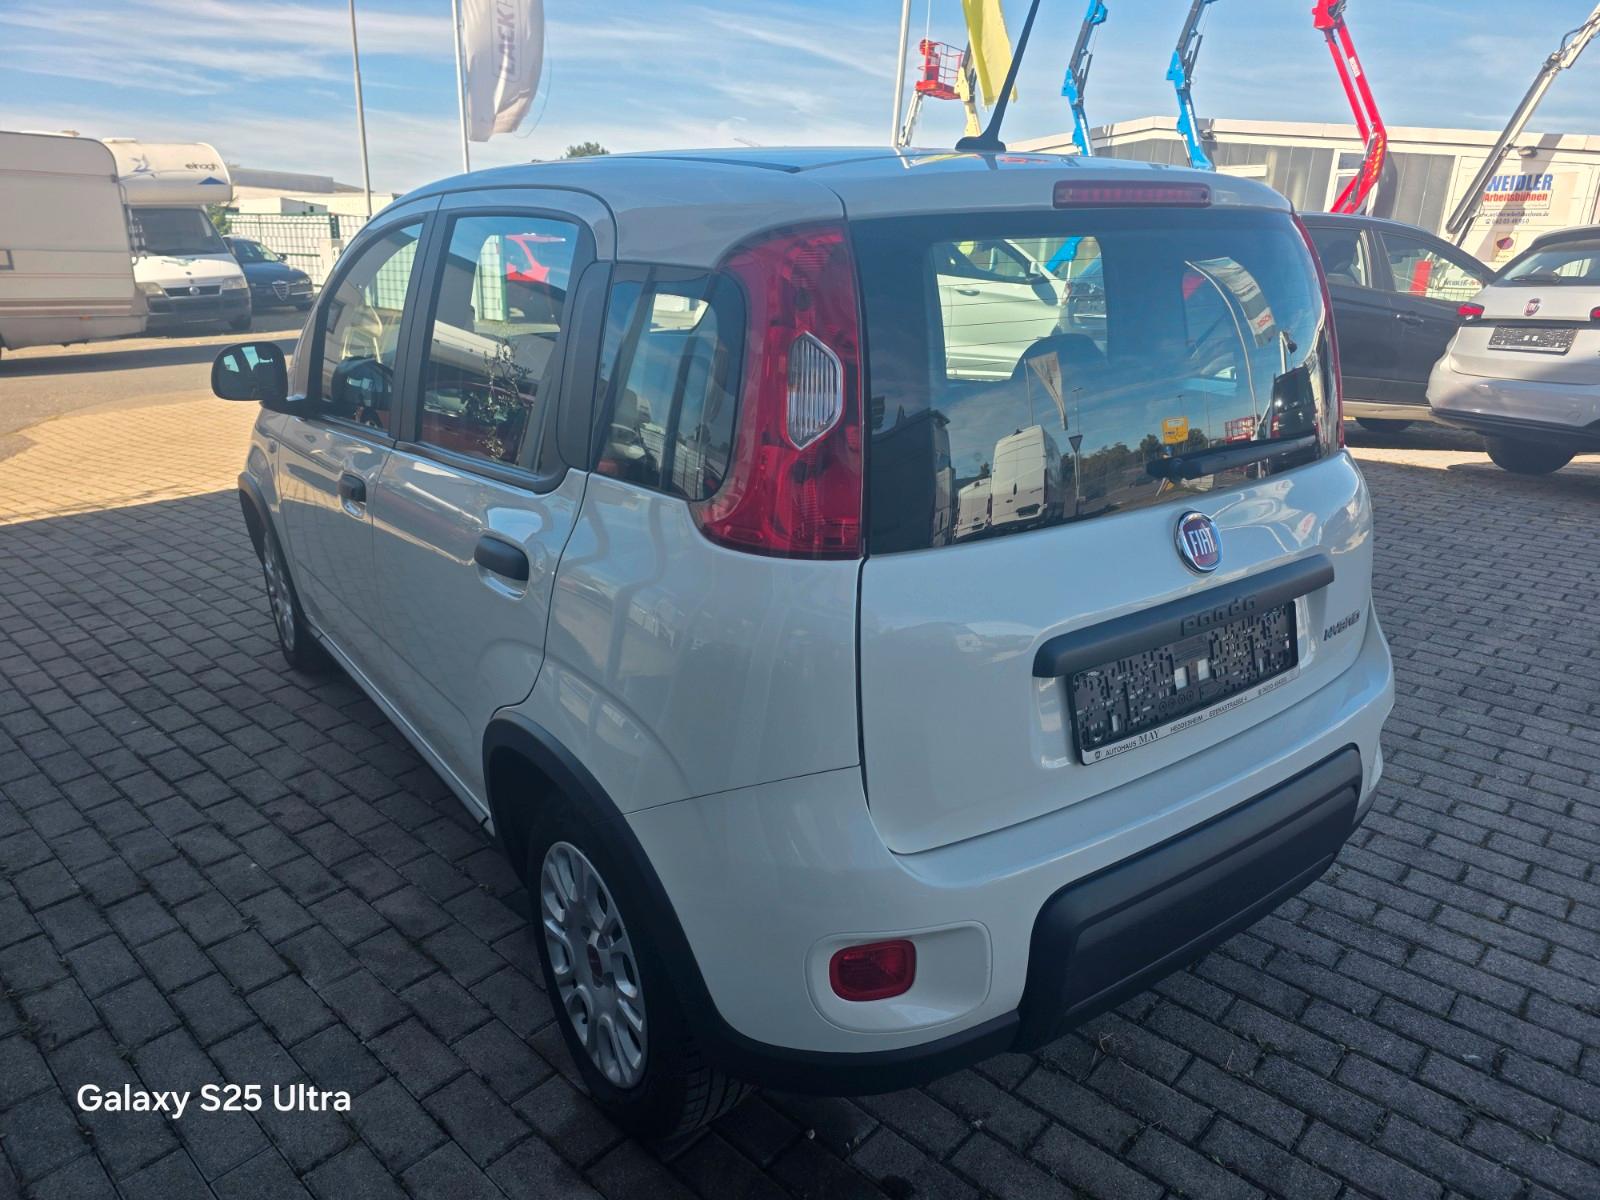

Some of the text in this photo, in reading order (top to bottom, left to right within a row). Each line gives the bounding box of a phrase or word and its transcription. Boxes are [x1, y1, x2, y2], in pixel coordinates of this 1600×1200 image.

[1483, 191, 1548, 203] Arbeitsbühnen
[1187, 525, 1216, 557] FIAT
[1105, 742, 1137, 757] AUTOHAUS
[1138, 730, 1161, 745] MAY
